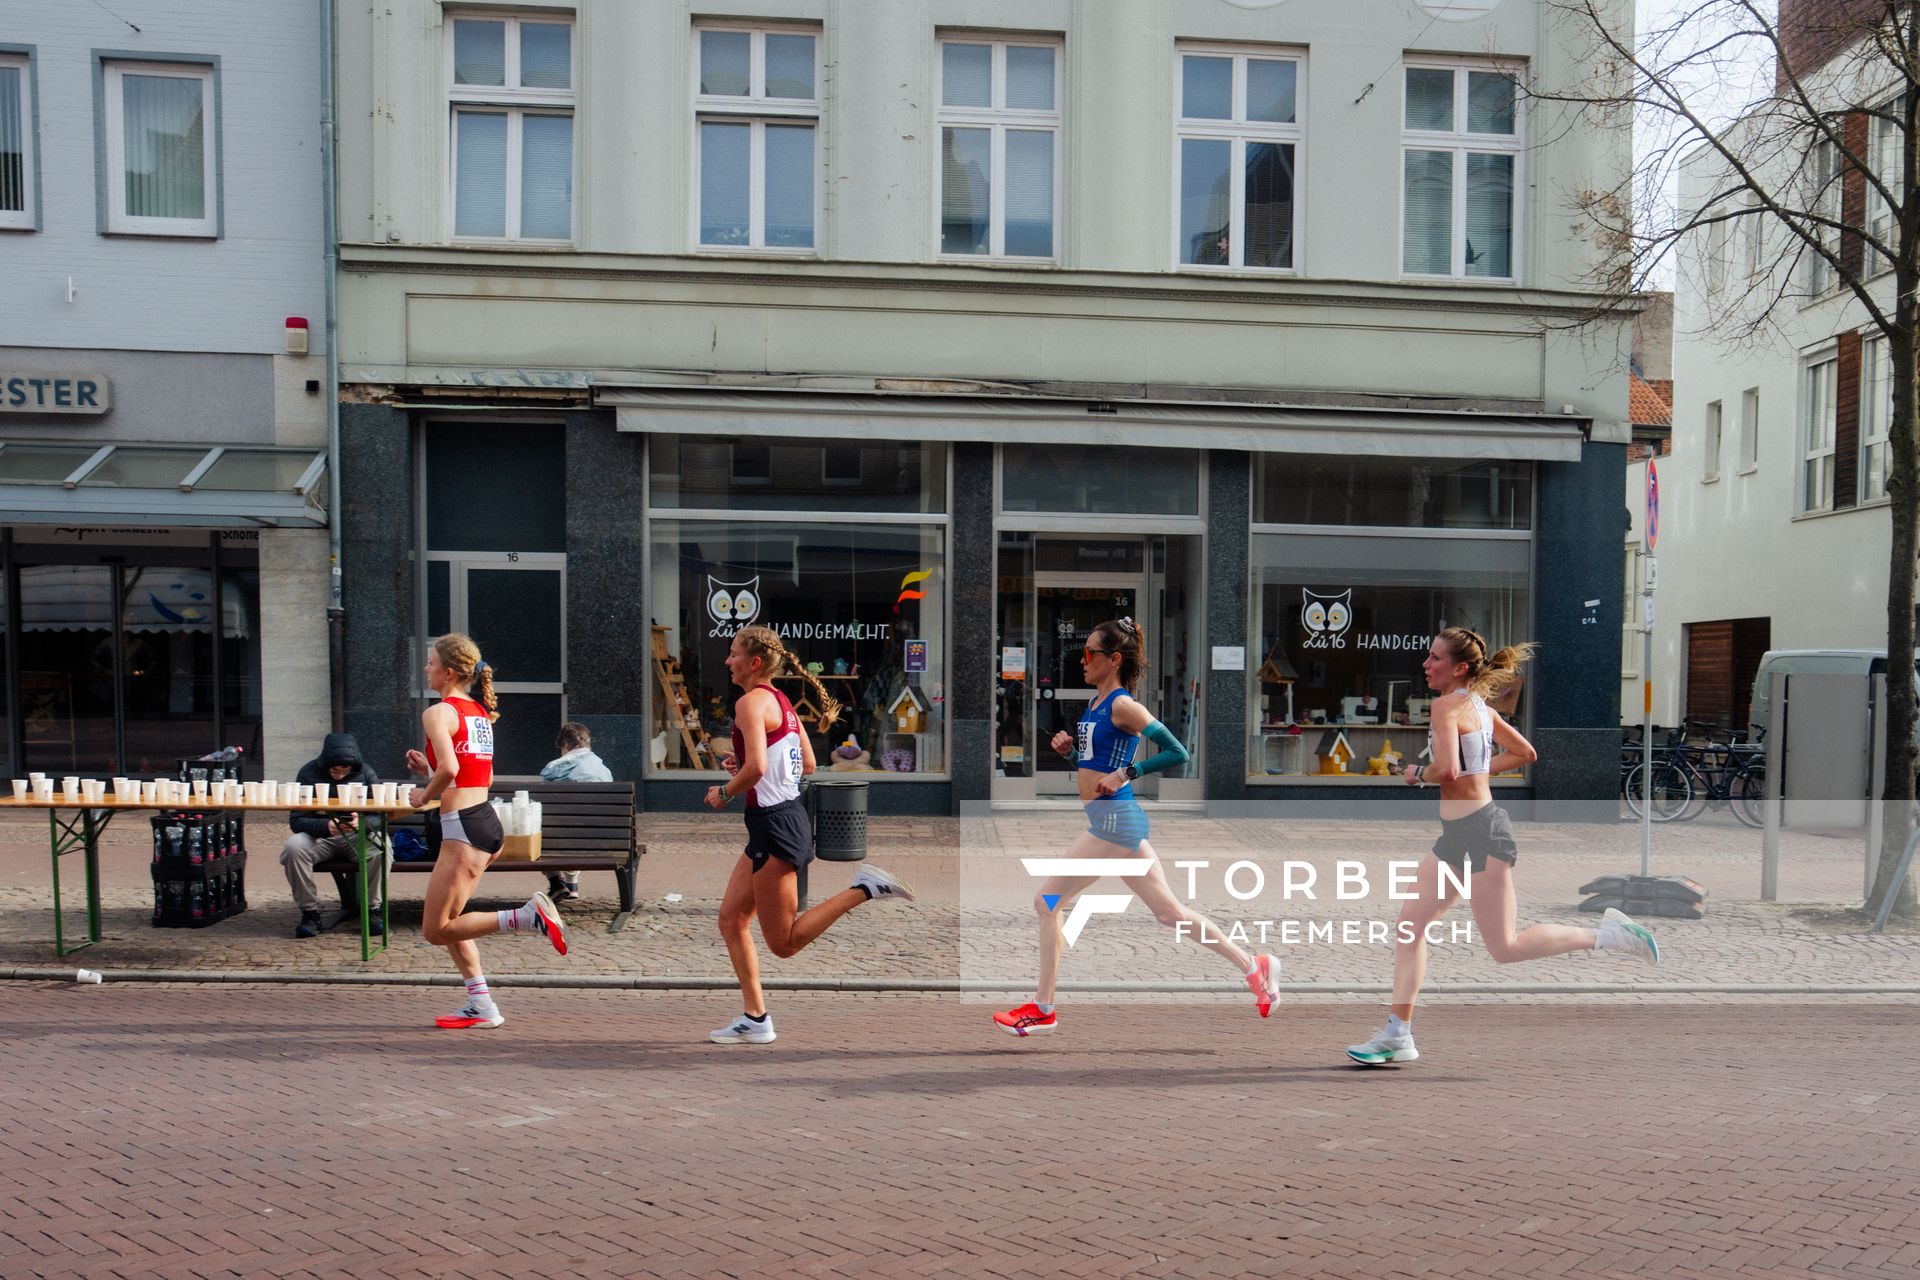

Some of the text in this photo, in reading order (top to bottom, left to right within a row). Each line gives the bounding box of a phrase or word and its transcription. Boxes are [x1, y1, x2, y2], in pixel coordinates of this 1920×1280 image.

[0, 377, 99, 407] STER
[506, 552, 519, 562] 16
[1115, 597, 1128, 606] 16
[709, 620, 752, 638] Lü1
[1303, 631, 1438, 651] Lü16 HANDGEM
